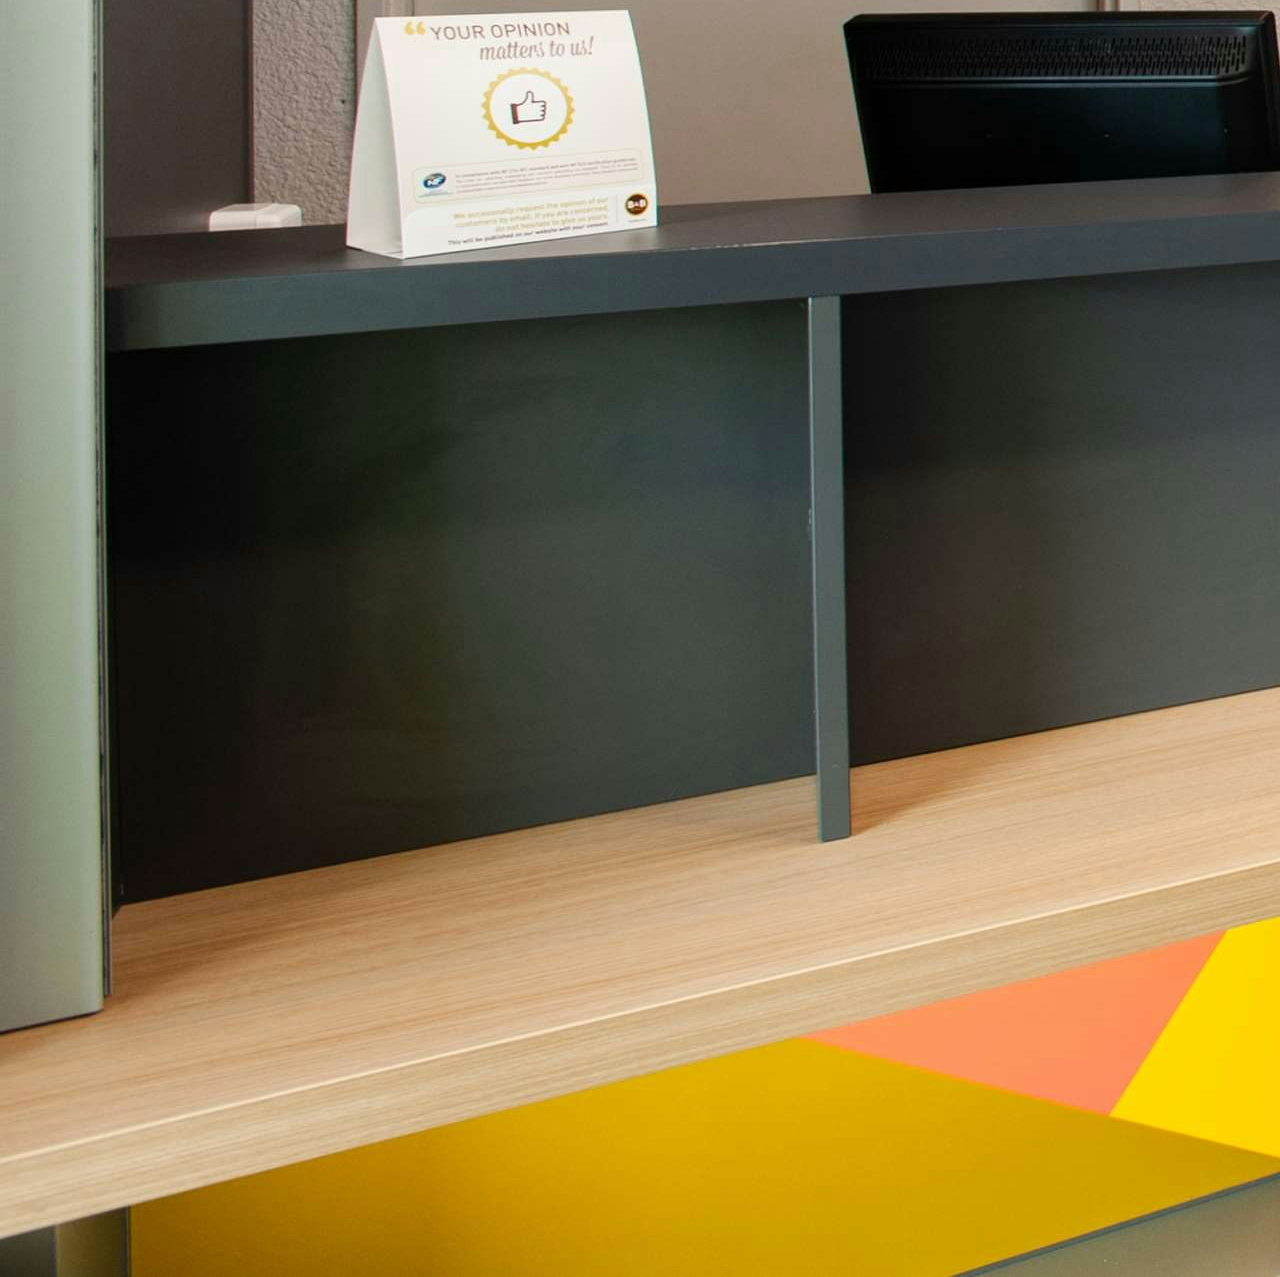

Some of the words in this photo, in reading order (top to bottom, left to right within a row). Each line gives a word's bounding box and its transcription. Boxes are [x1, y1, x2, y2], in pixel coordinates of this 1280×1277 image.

[430, 24, 486, 41] YOUR
[490, 22, 570, 39] OPINION
[479, 41, 545, 60] matters
[549, 41, 565, 58] to
[570, 36, 594, 56] us!
